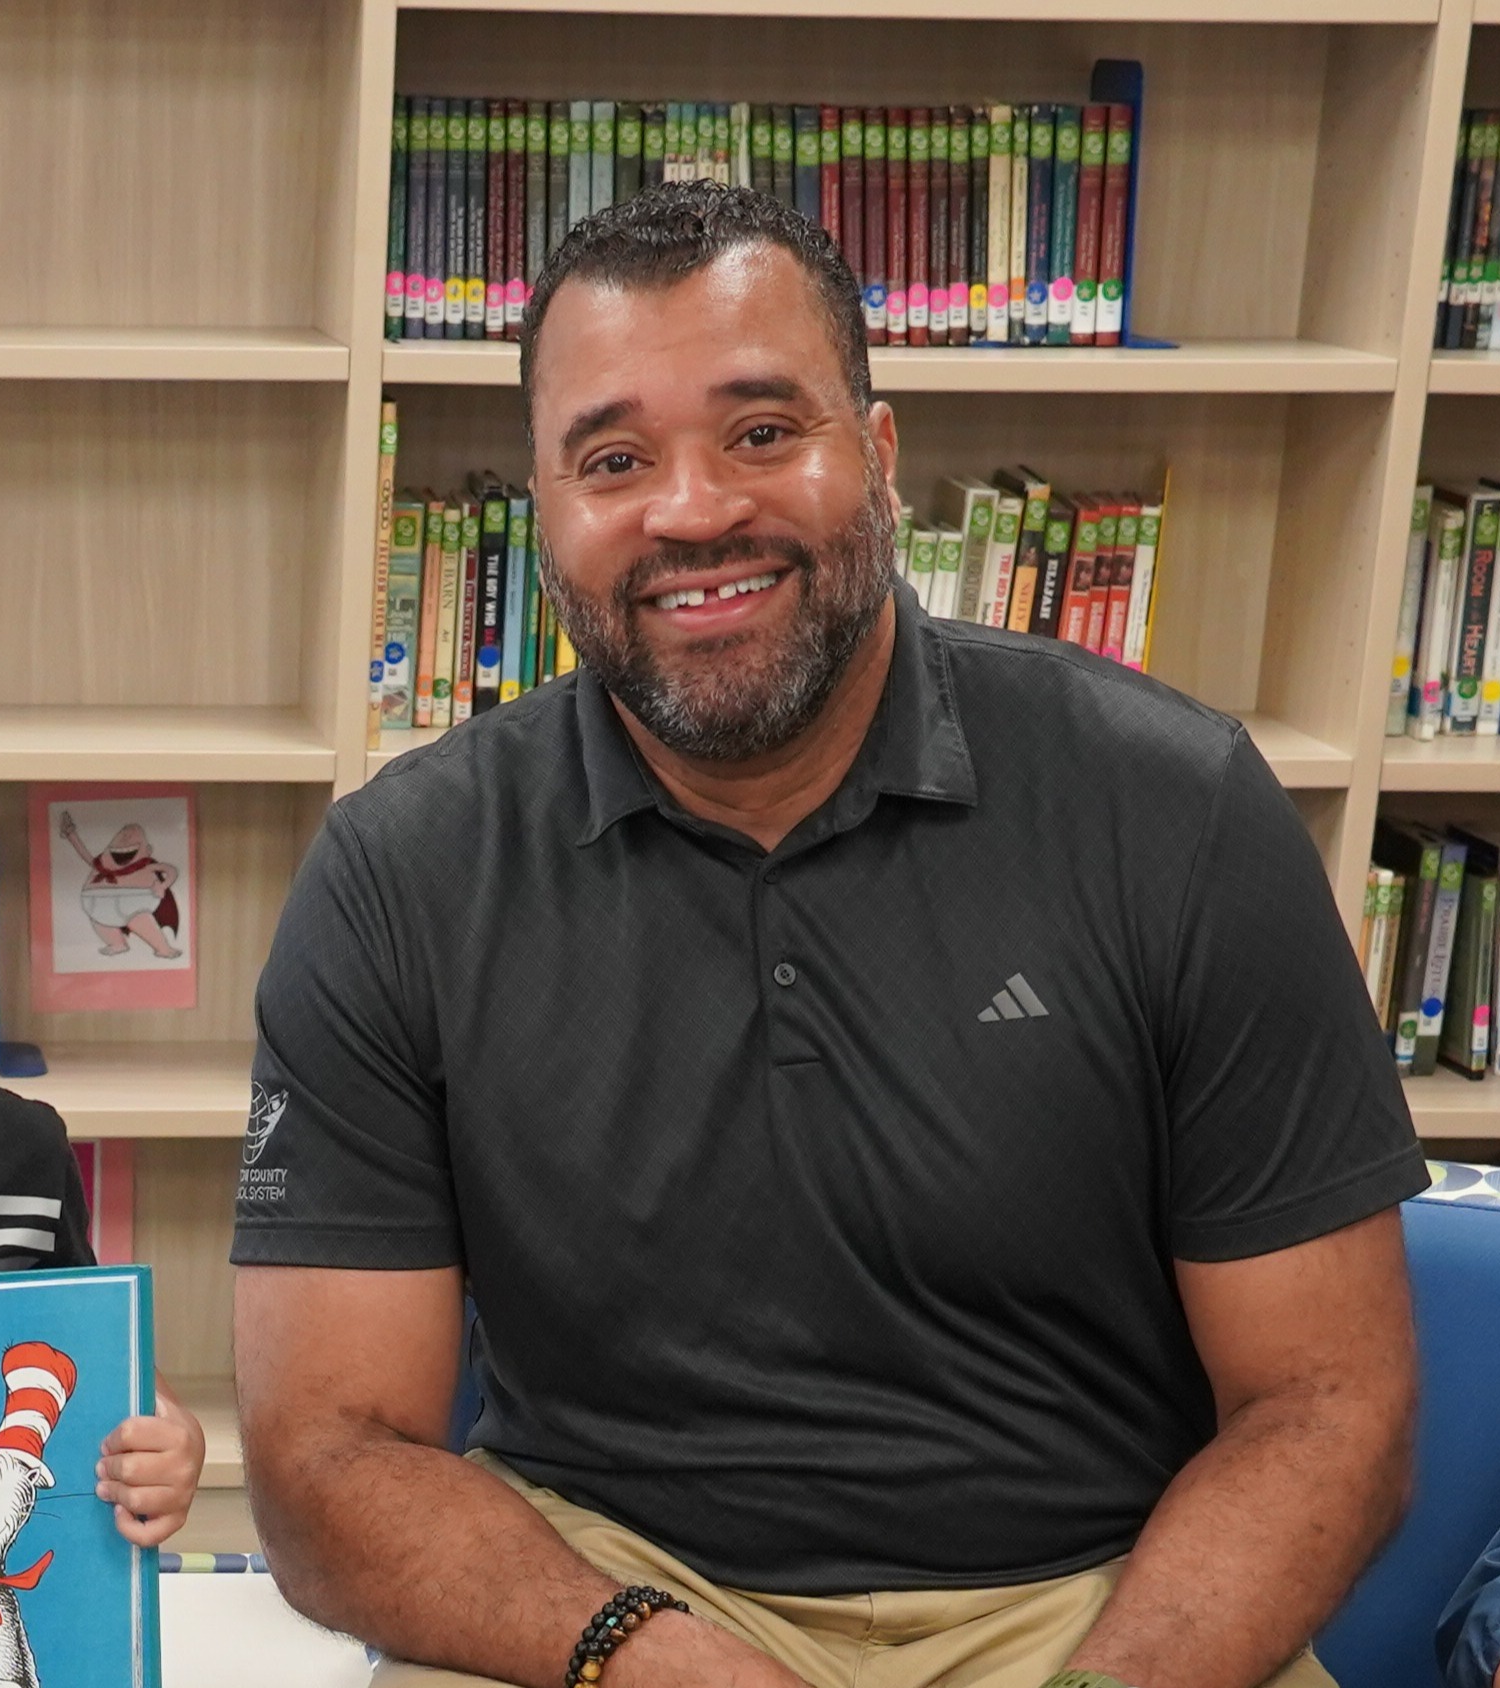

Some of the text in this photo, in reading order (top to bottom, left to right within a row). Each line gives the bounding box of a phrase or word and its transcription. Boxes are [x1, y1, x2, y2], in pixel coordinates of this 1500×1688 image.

[1040, 559, 1058, 619] ELIJAH
[251, 1168, 288, 1183] COUNTY
[249, 1186, 286, 1200] SYSTEM
